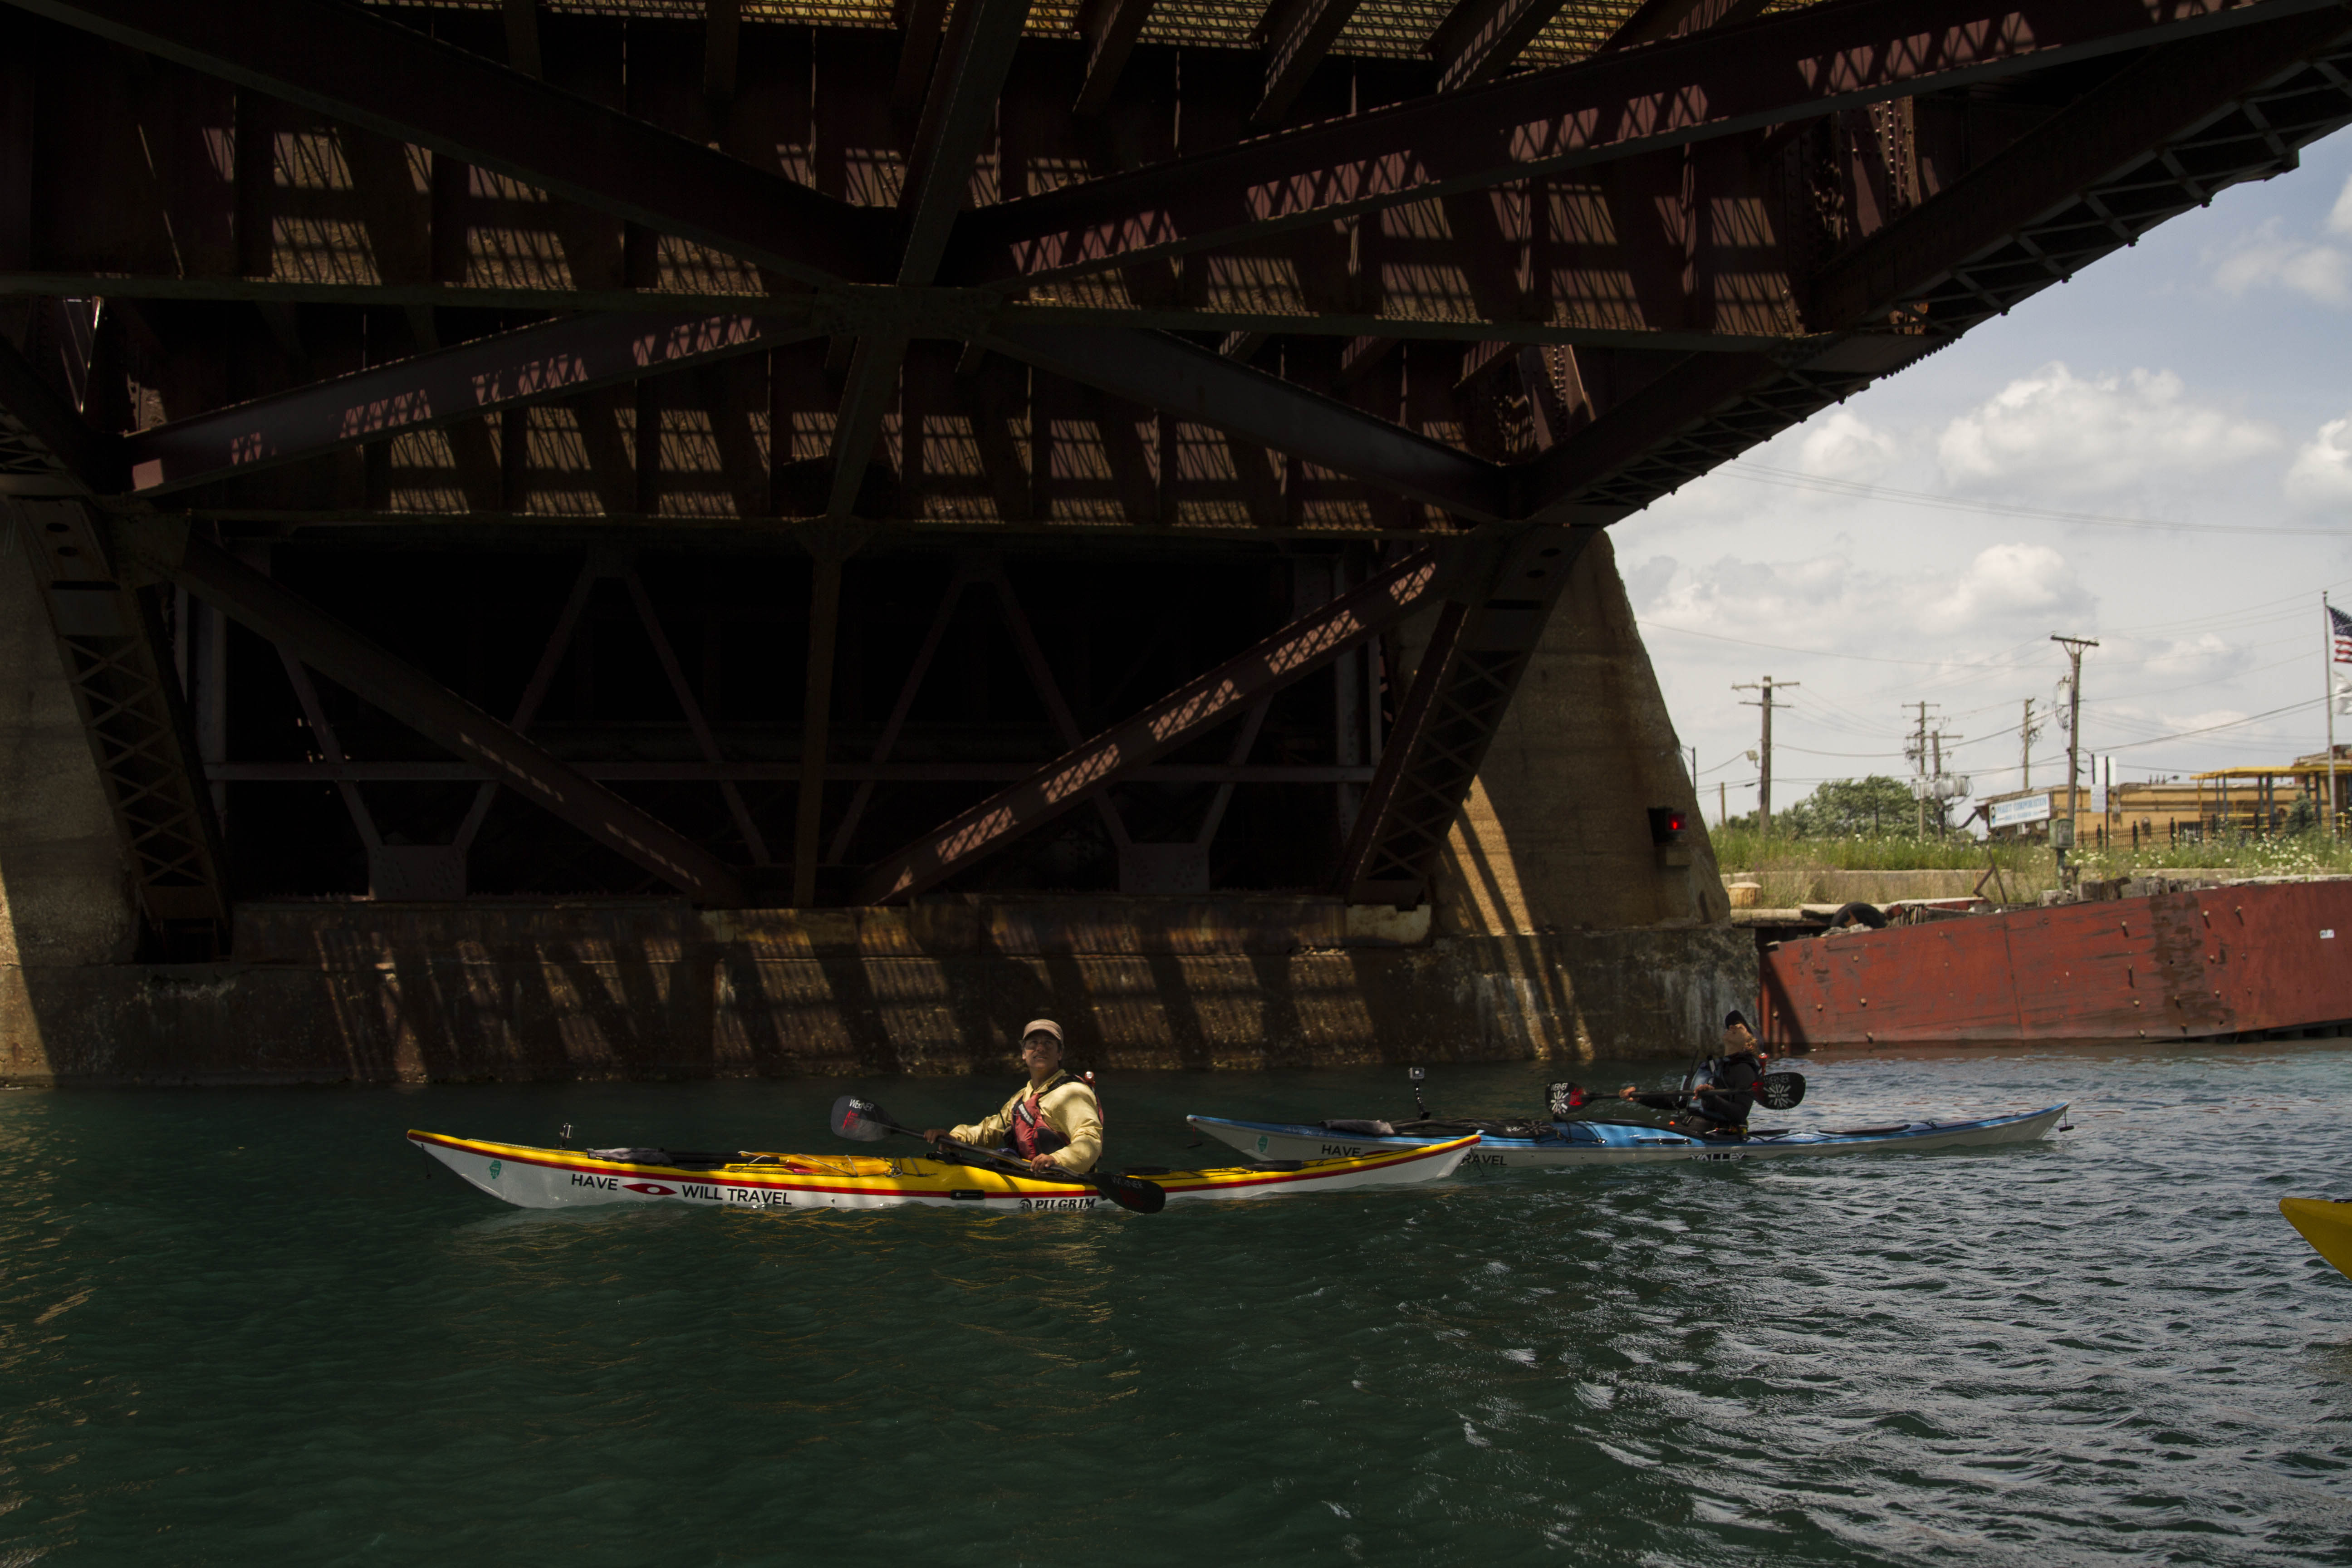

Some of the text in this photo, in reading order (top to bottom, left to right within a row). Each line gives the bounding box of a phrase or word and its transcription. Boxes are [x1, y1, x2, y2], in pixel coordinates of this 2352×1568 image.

[849, 1098, 875, 1112] WERNER
[1321, 1144, 1508, 1166] HAVE RAVEL
[1690, 1152, 1746, 1162] VALLEY
[571, 1174, 792, 1205] HAVE WILL TRAVEL
[1035, 1198, 1097, 1209] PILGRIM
